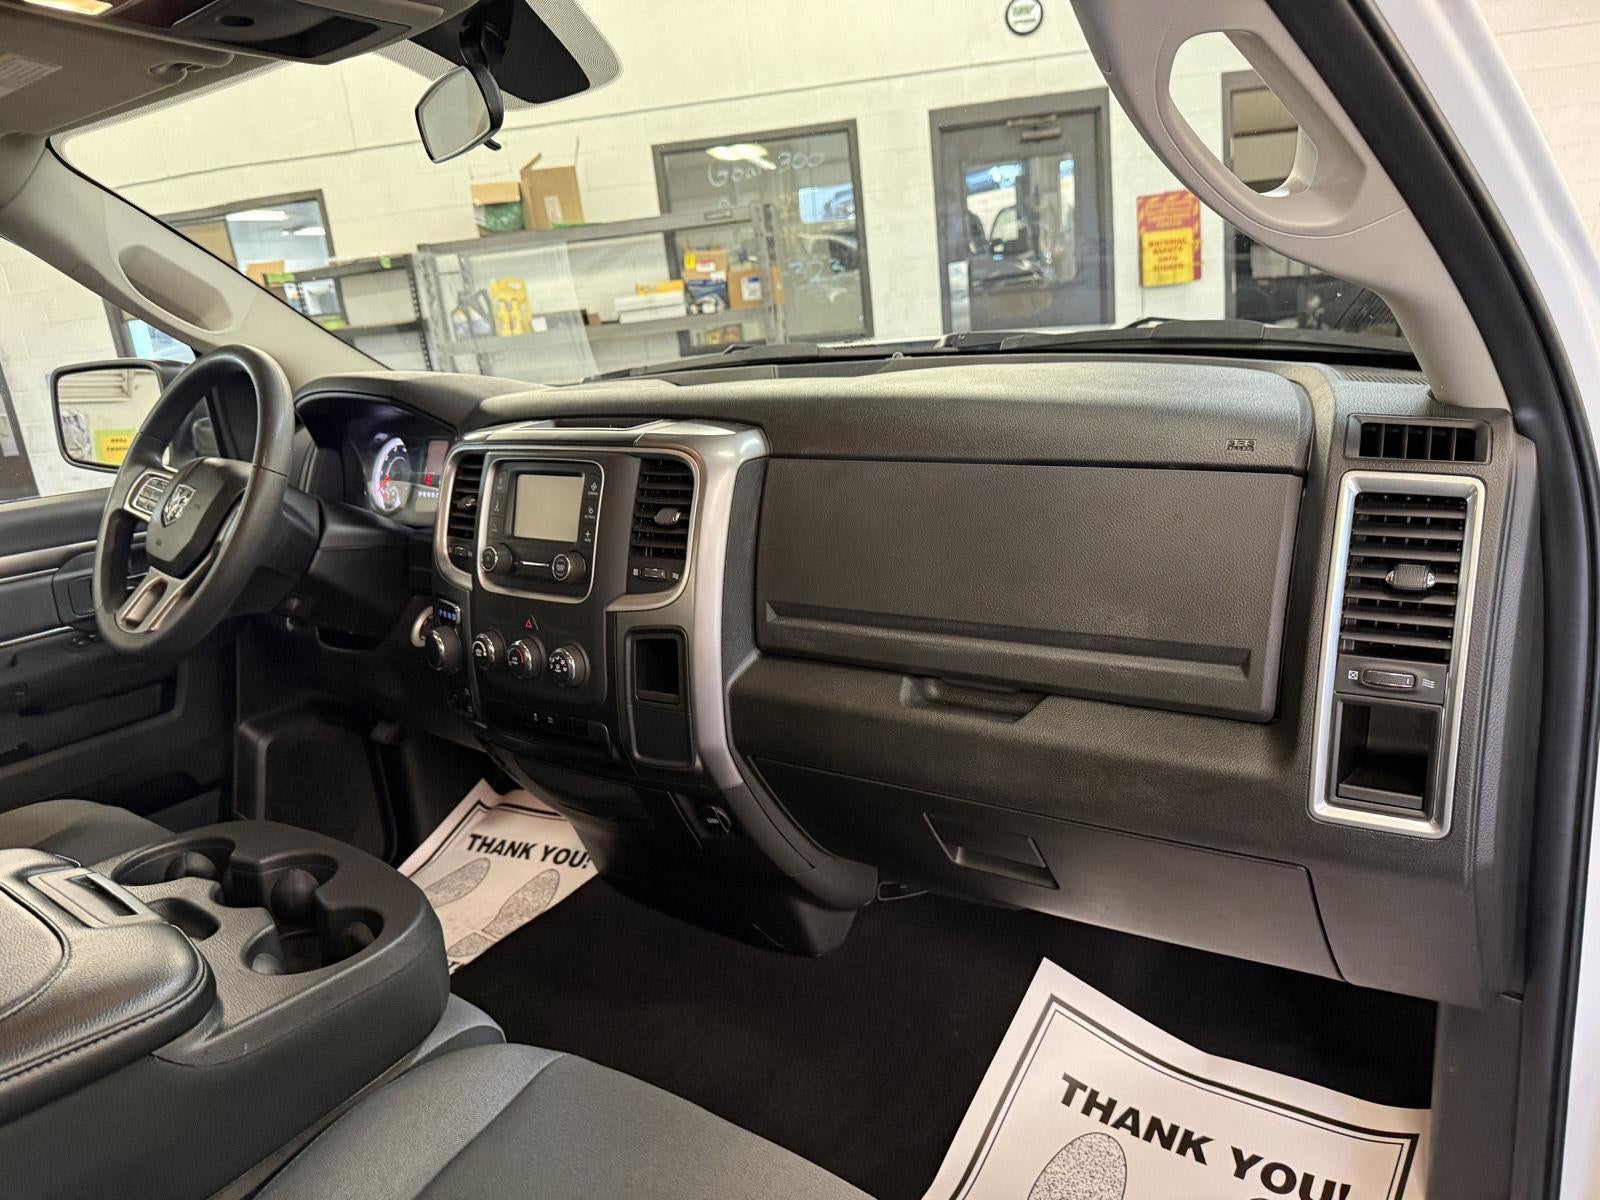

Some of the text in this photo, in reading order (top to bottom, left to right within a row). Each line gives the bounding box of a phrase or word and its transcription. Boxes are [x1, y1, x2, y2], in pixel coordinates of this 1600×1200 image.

[466, 834, 592, 869] THANK YOU!
[1060, 1072, 1215, 1166] THANK
